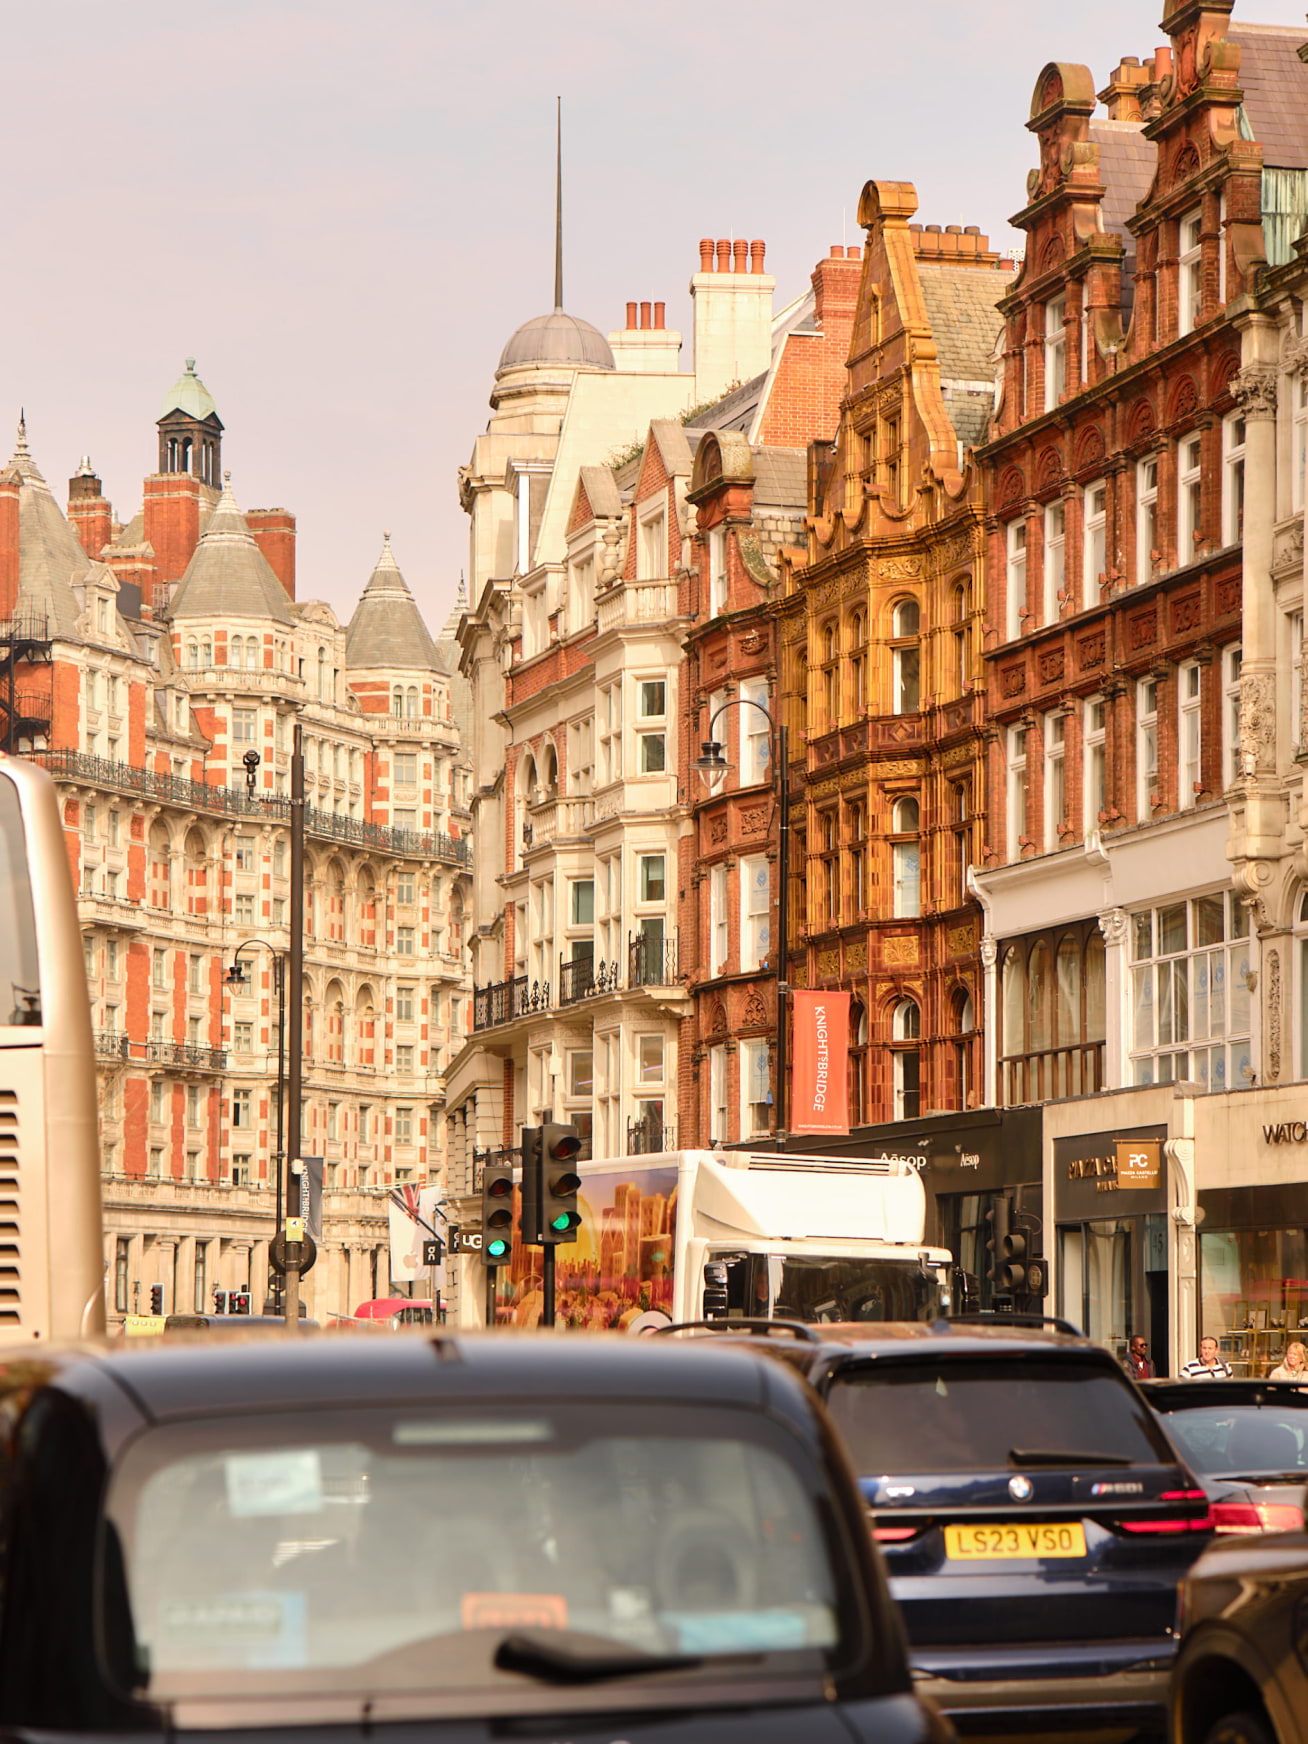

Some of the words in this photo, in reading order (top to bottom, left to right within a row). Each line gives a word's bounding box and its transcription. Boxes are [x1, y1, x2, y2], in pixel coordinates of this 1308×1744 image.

[1129, 1153, 1148, 1168] PC
[462, 1234, 482, 1249] UG
[957, 1529, 1020, 1553] LS23
